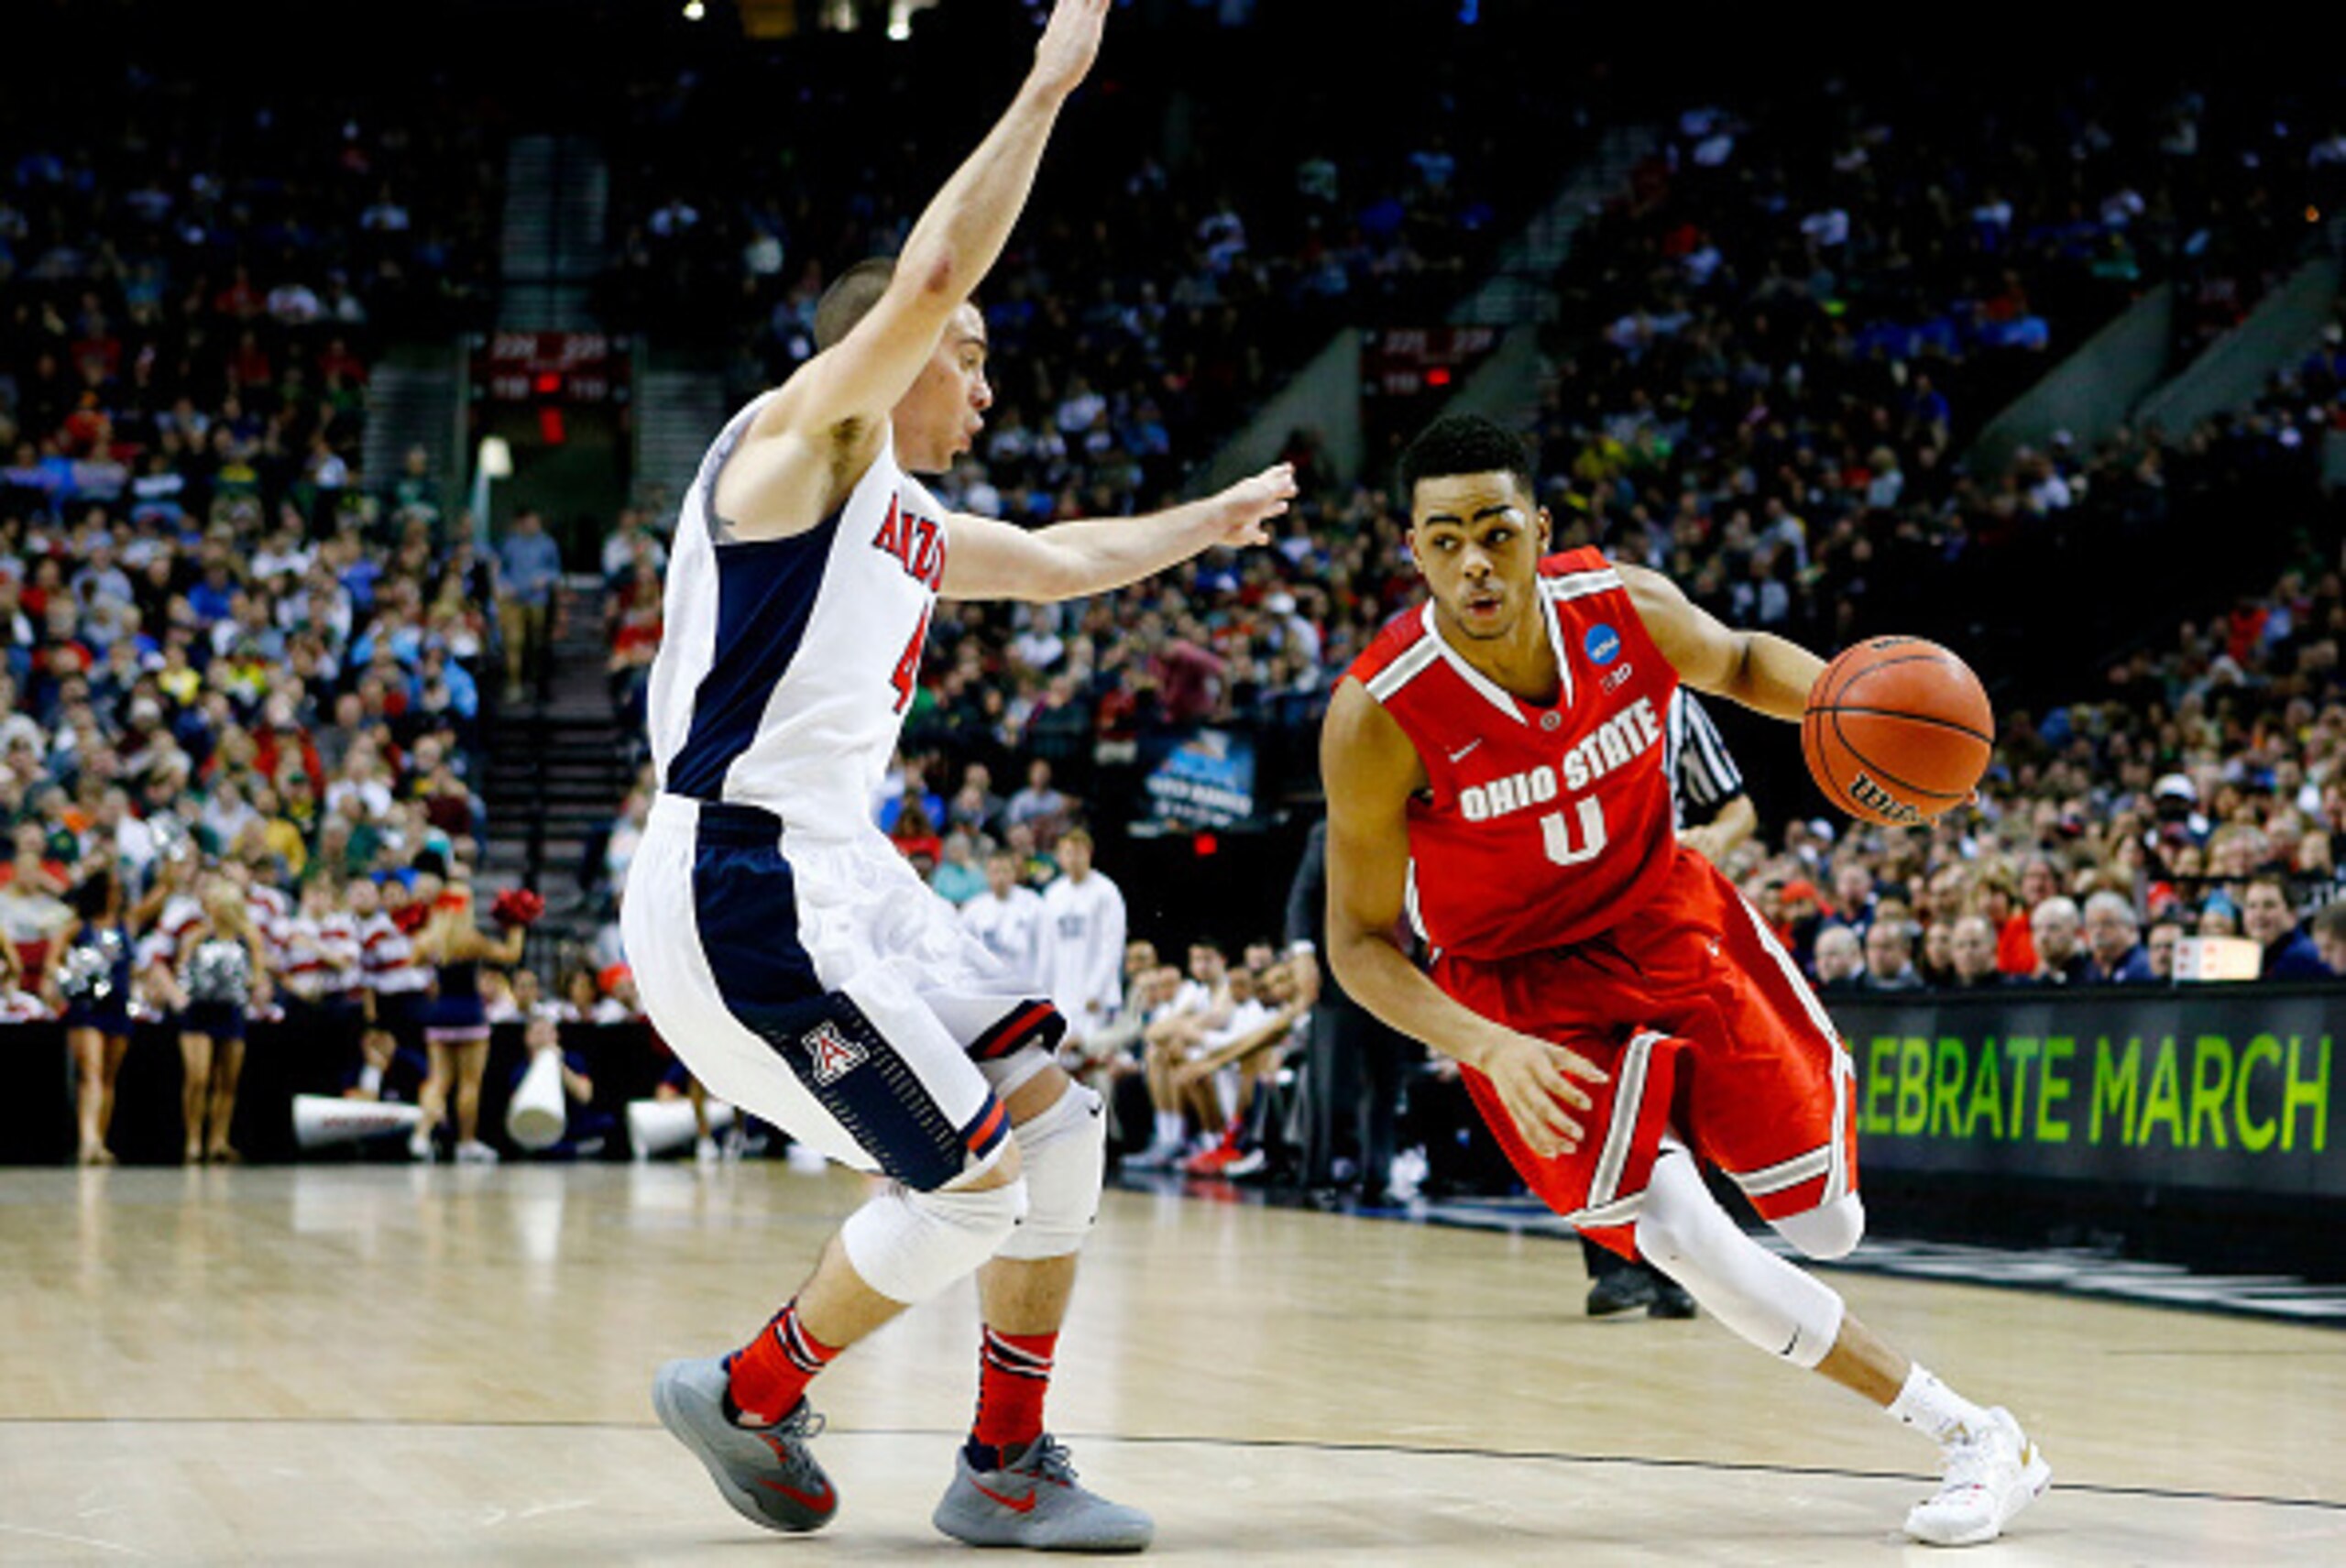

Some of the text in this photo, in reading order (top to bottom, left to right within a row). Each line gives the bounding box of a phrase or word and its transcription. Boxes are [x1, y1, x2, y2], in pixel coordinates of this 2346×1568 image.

[1460, 696, 1660, 820] OHIO STATE
[1848, 1033, 2332, 1153] EBRATE MARCH
